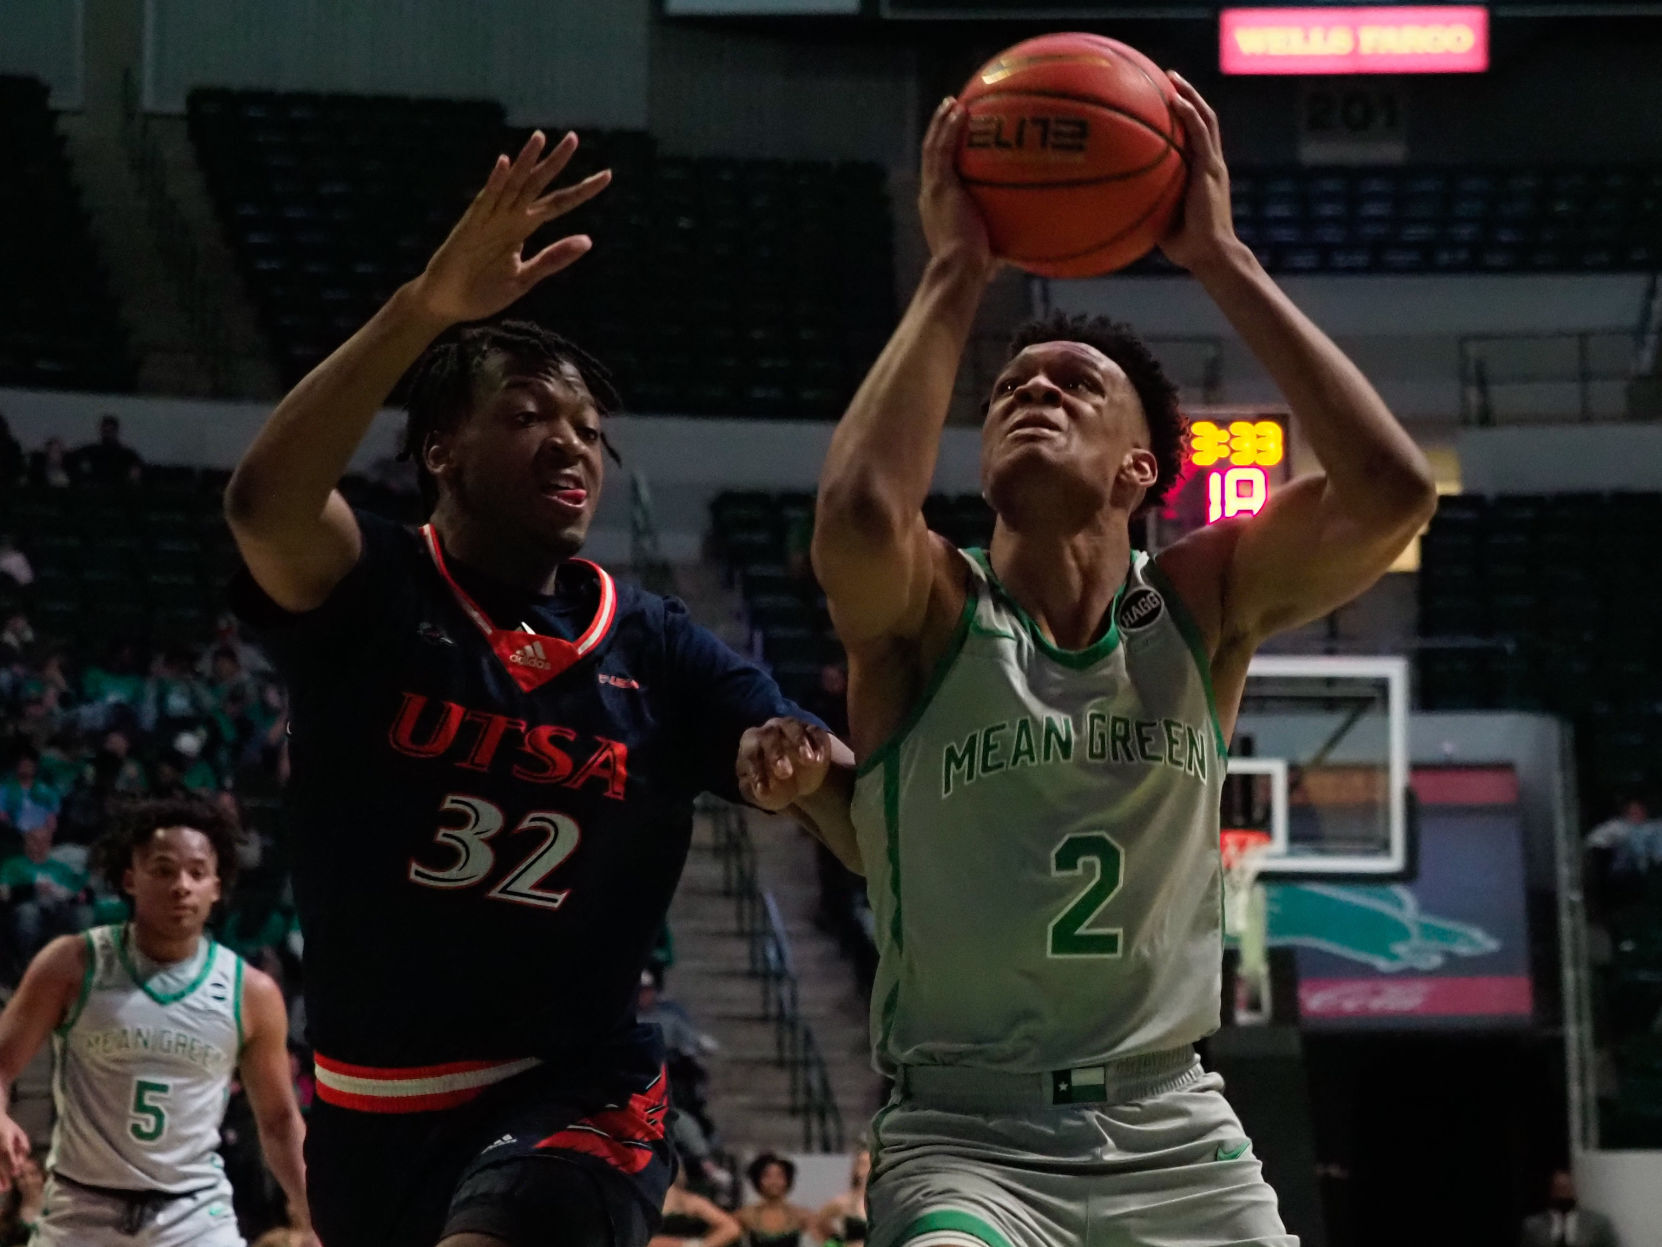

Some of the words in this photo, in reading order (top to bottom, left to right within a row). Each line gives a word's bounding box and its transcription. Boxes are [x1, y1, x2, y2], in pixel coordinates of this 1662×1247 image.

[967, 115, 1089, 151] ELITE
[509, 654, 551, 670] adidas
[388, 691, 628, 800] UTSA
[942, 715, 1074, 799] MEAN
[1086, 710, 1207, 786] GREEN
[409, 793, 581, 910] 32
[1047, 830, 1125, 959] 2
[127, 1077, 171, 1144] 5
